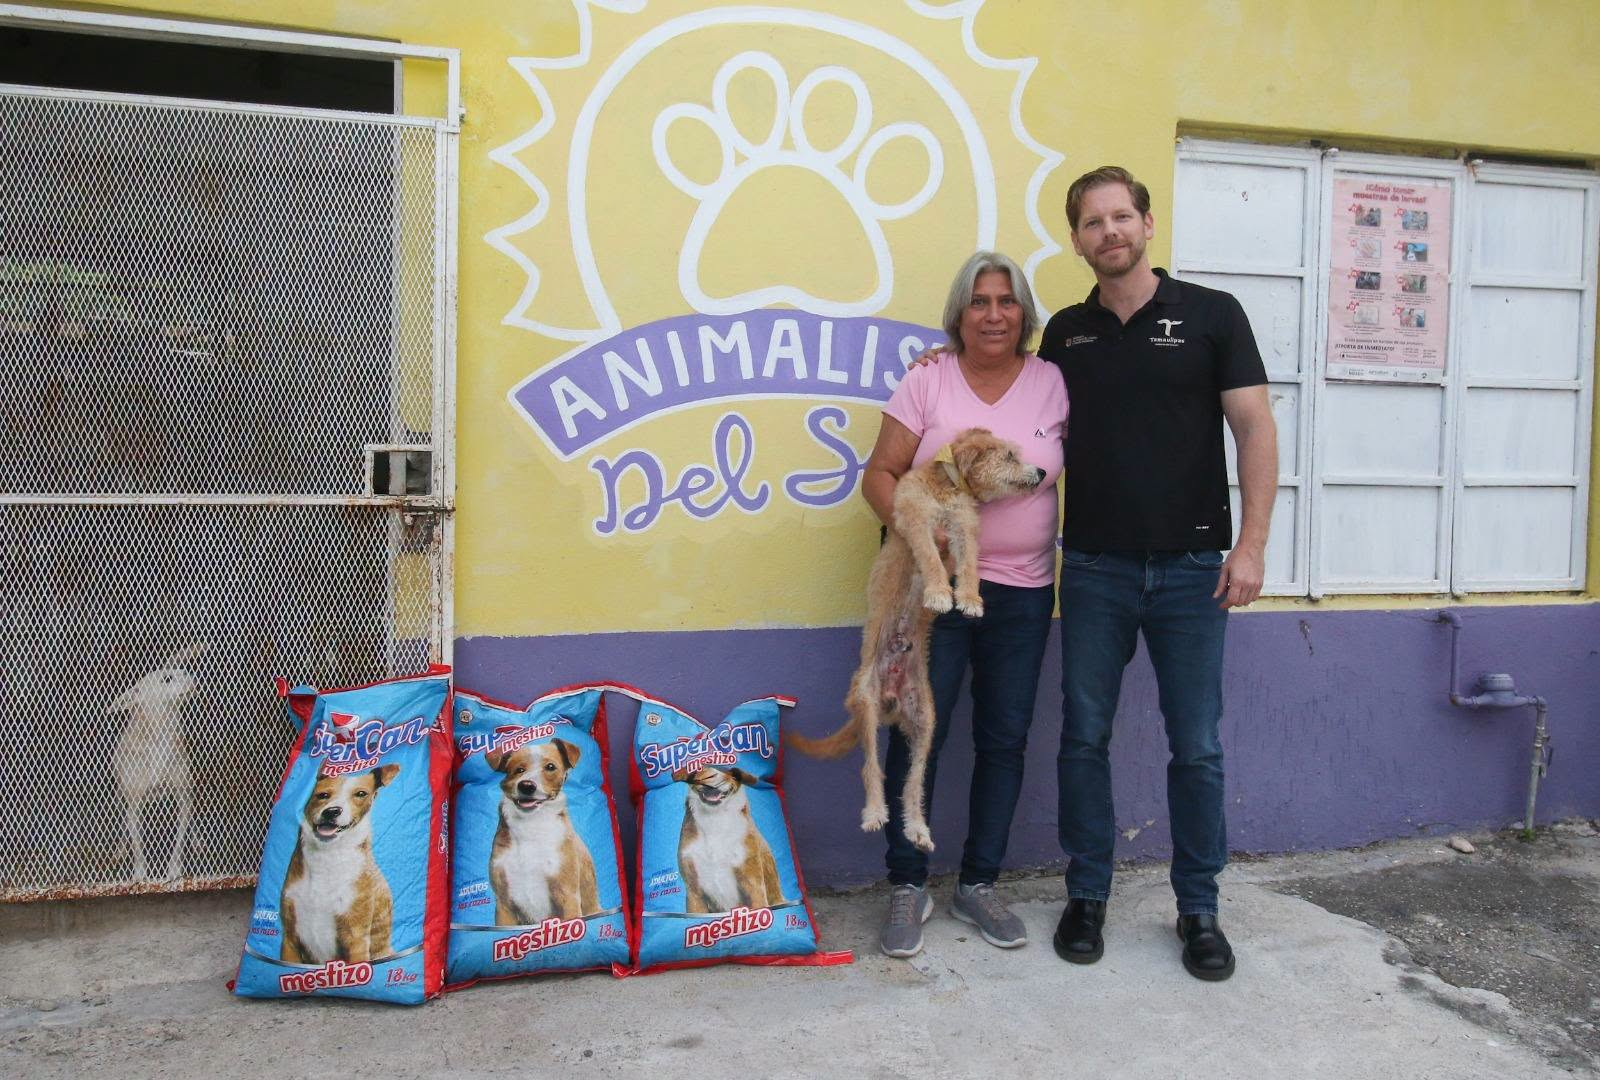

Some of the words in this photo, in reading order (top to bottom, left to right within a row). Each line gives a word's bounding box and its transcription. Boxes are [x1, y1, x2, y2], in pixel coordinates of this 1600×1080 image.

[549, 319, 944, 438] ANIMALIS
[590, 412, 771, 536] Del
[502, 723, 555, 755] mestizo
[641, 723, 771, 778] SuperCan
[687, 750, 736, 774] mestizo
[493, 919, 586, 961] mestizo
[686, 907, 773, 948] mestizo
[281, 961, 372, 992] mestizo
